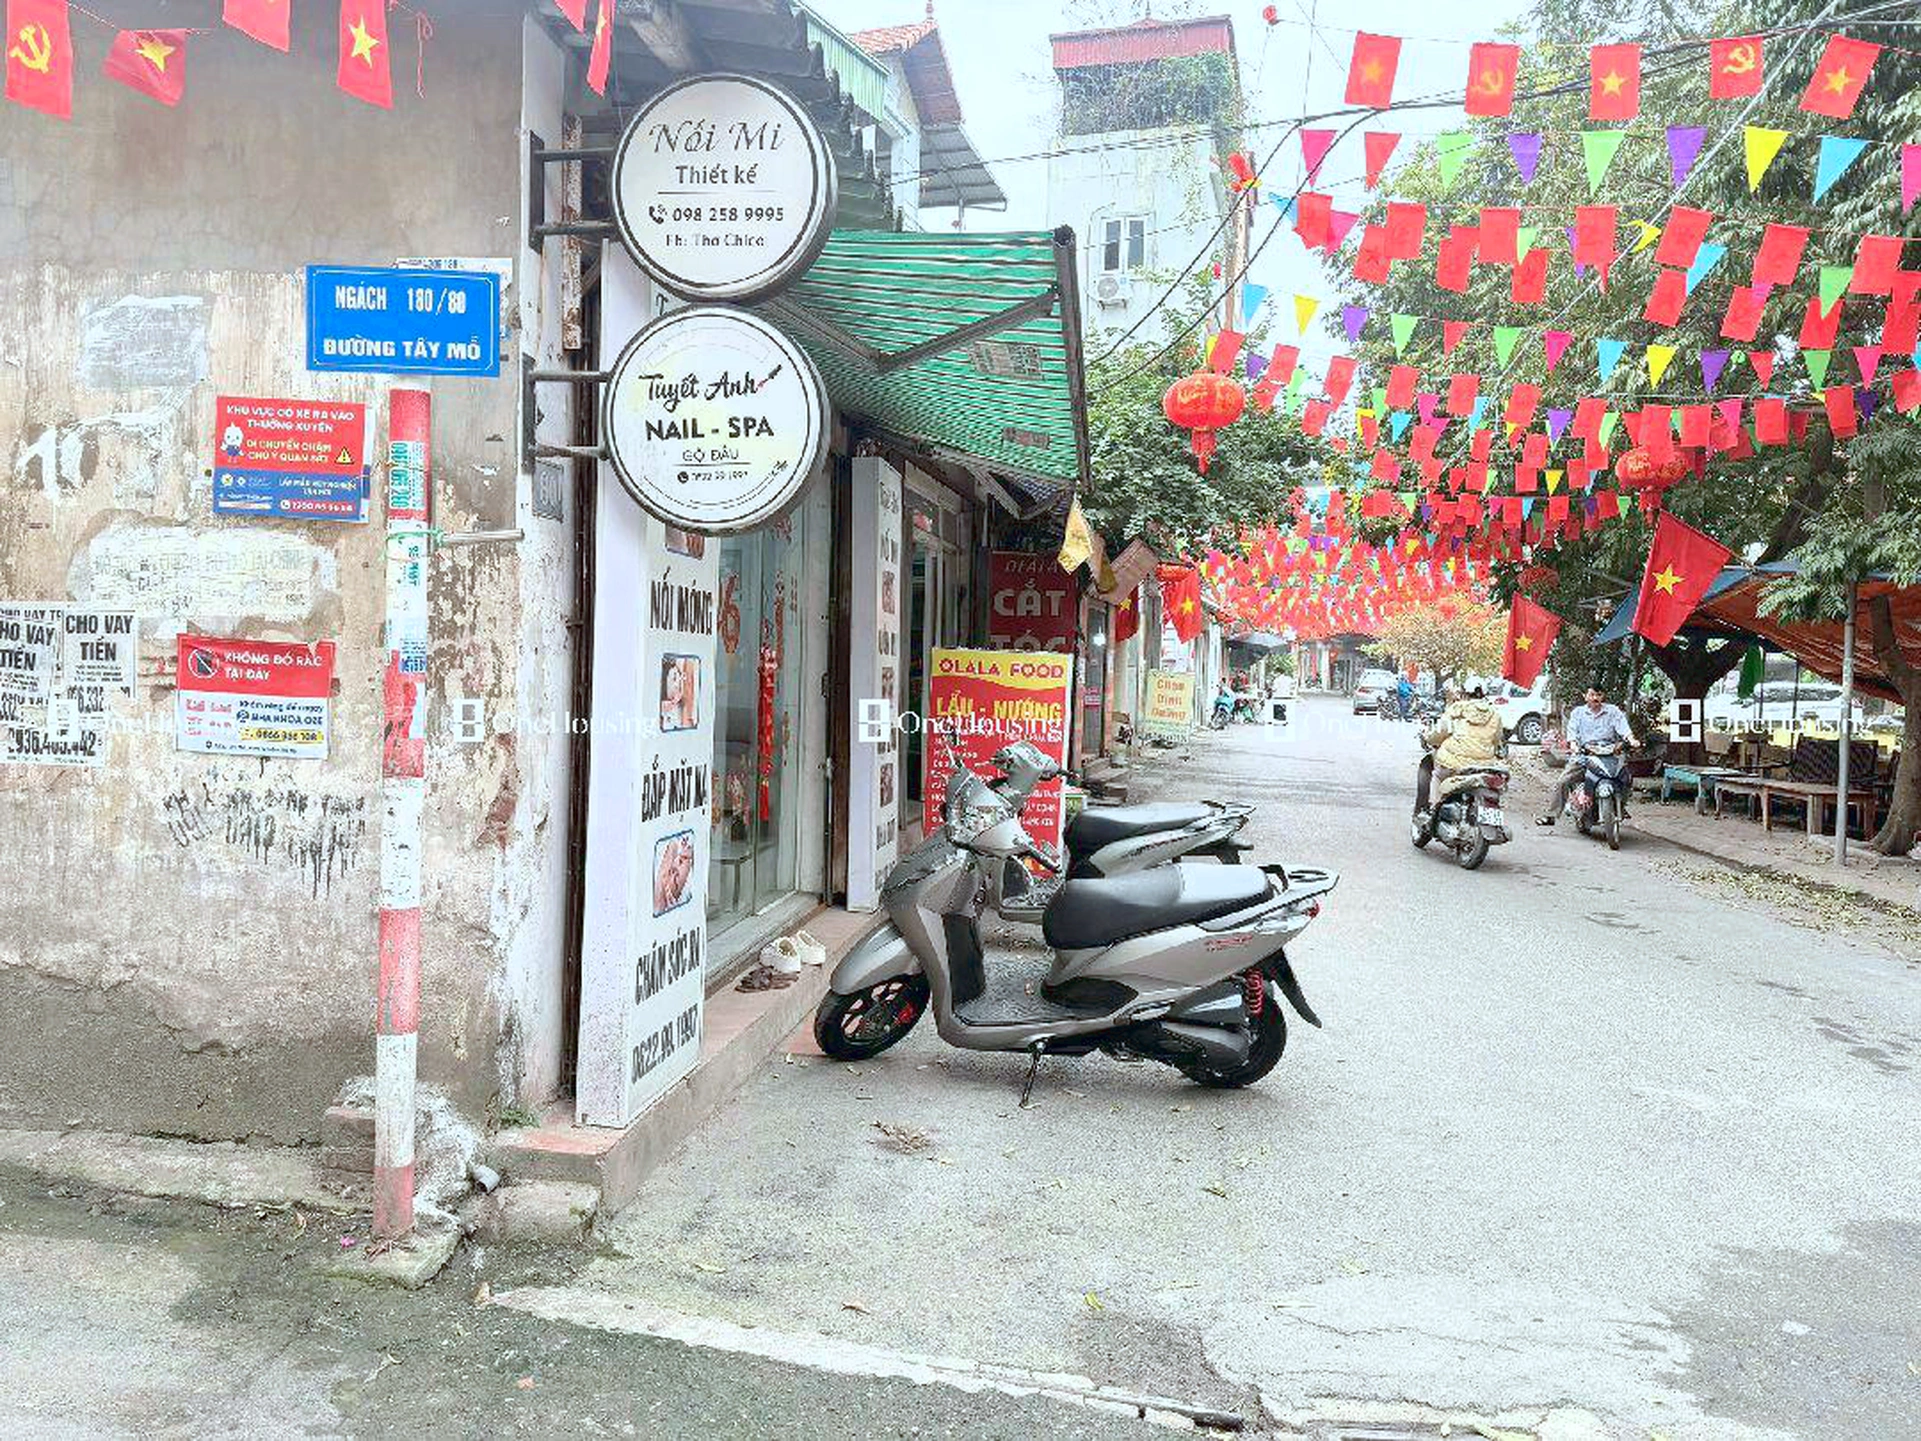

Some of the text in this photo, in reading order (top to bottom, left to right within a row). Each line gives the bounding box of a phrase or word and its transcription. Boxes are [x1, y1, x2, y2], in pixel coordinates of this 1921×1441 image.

[649, 119, 785, 152] Nối Mi
[675, 163, 759, 184] Thiết kế
[672, 207, 784, 222] 098 258 9995
[335, 281, 387, 311] NGÁCH
[323, 334, 396, 357] ĐƯỜNG
[402, 337, 440, 359] TÂY
[638, 371, 758, 413] Tuyết Anh
[227, 405, 250, 415] KHU
[645, 418, 705, 441] NAIL
[728, 416, 774, 438] SPA
[650, 567, 673, 630] NỐI
[994, 578, 1066, 616] CẮT
[0, 621, 55, 646] HO VAY
[65, 614, 98, 634] CHO
[104, 614, 134, 634] VAY
[224, 650, 269, 665] KHÔNG
[939, 658, 1063, 678] OLALA FOOD
[224, 667, 243, 682] TẠI
[994, 697, 1061, 720] NƯỚNG
